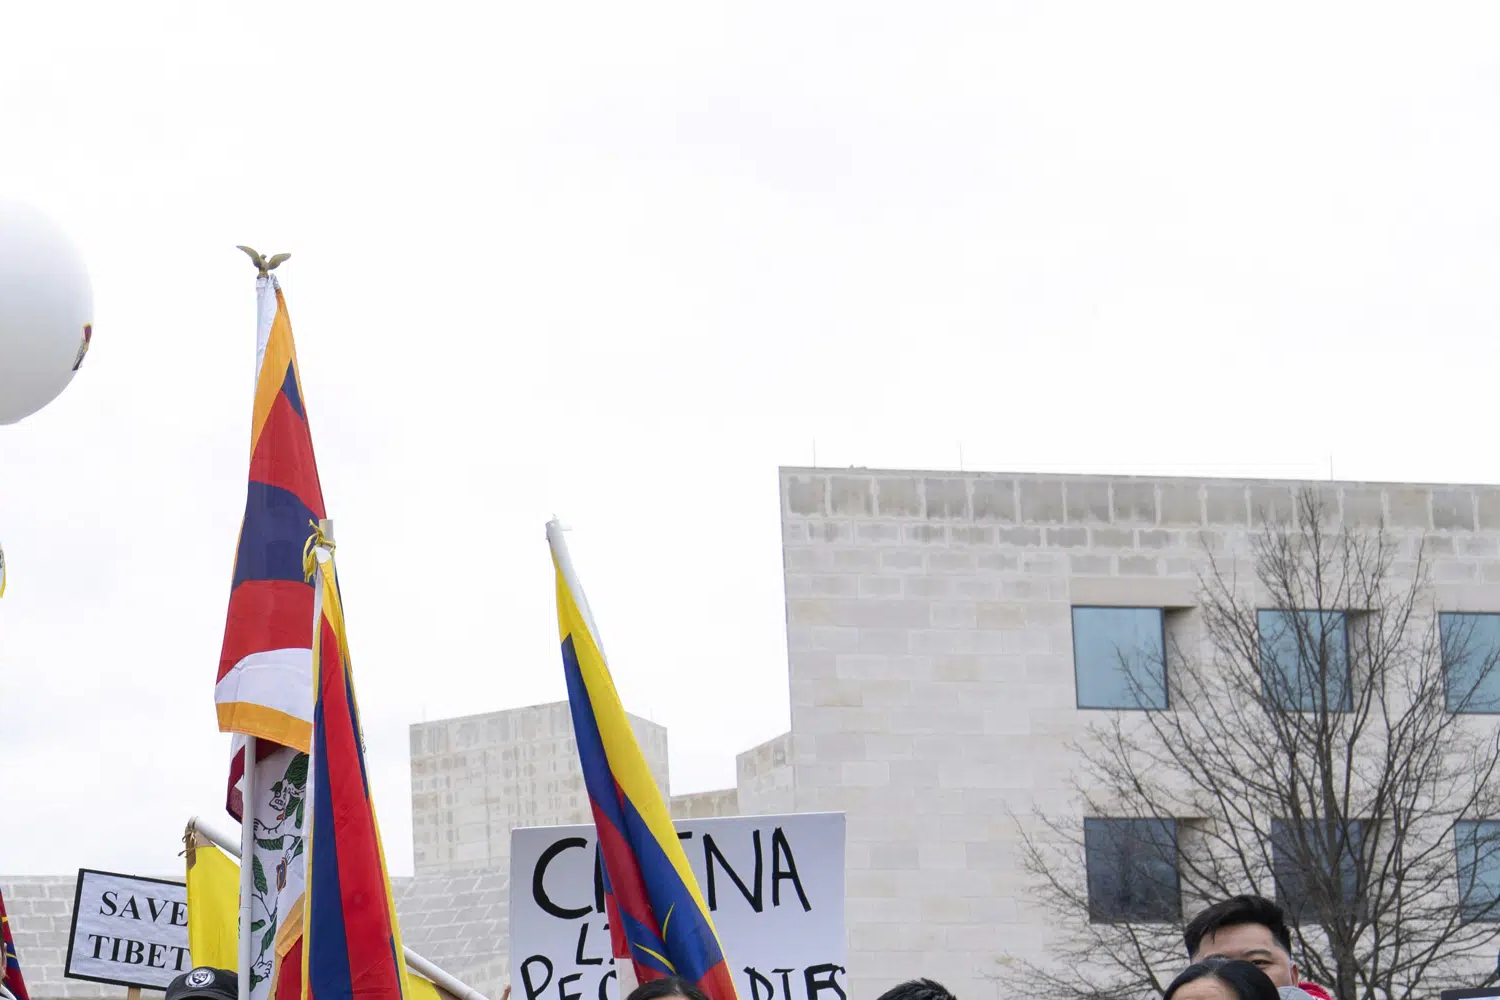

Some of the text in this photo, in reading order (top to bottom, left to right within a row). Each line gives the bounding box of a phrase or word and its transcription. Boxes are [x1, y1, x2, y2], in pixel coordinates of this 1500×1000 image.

[532, 826, 812, 920] CNA
[99, 890, 188, 927] SAVE
[88, 933, 192, 972] TIBET
